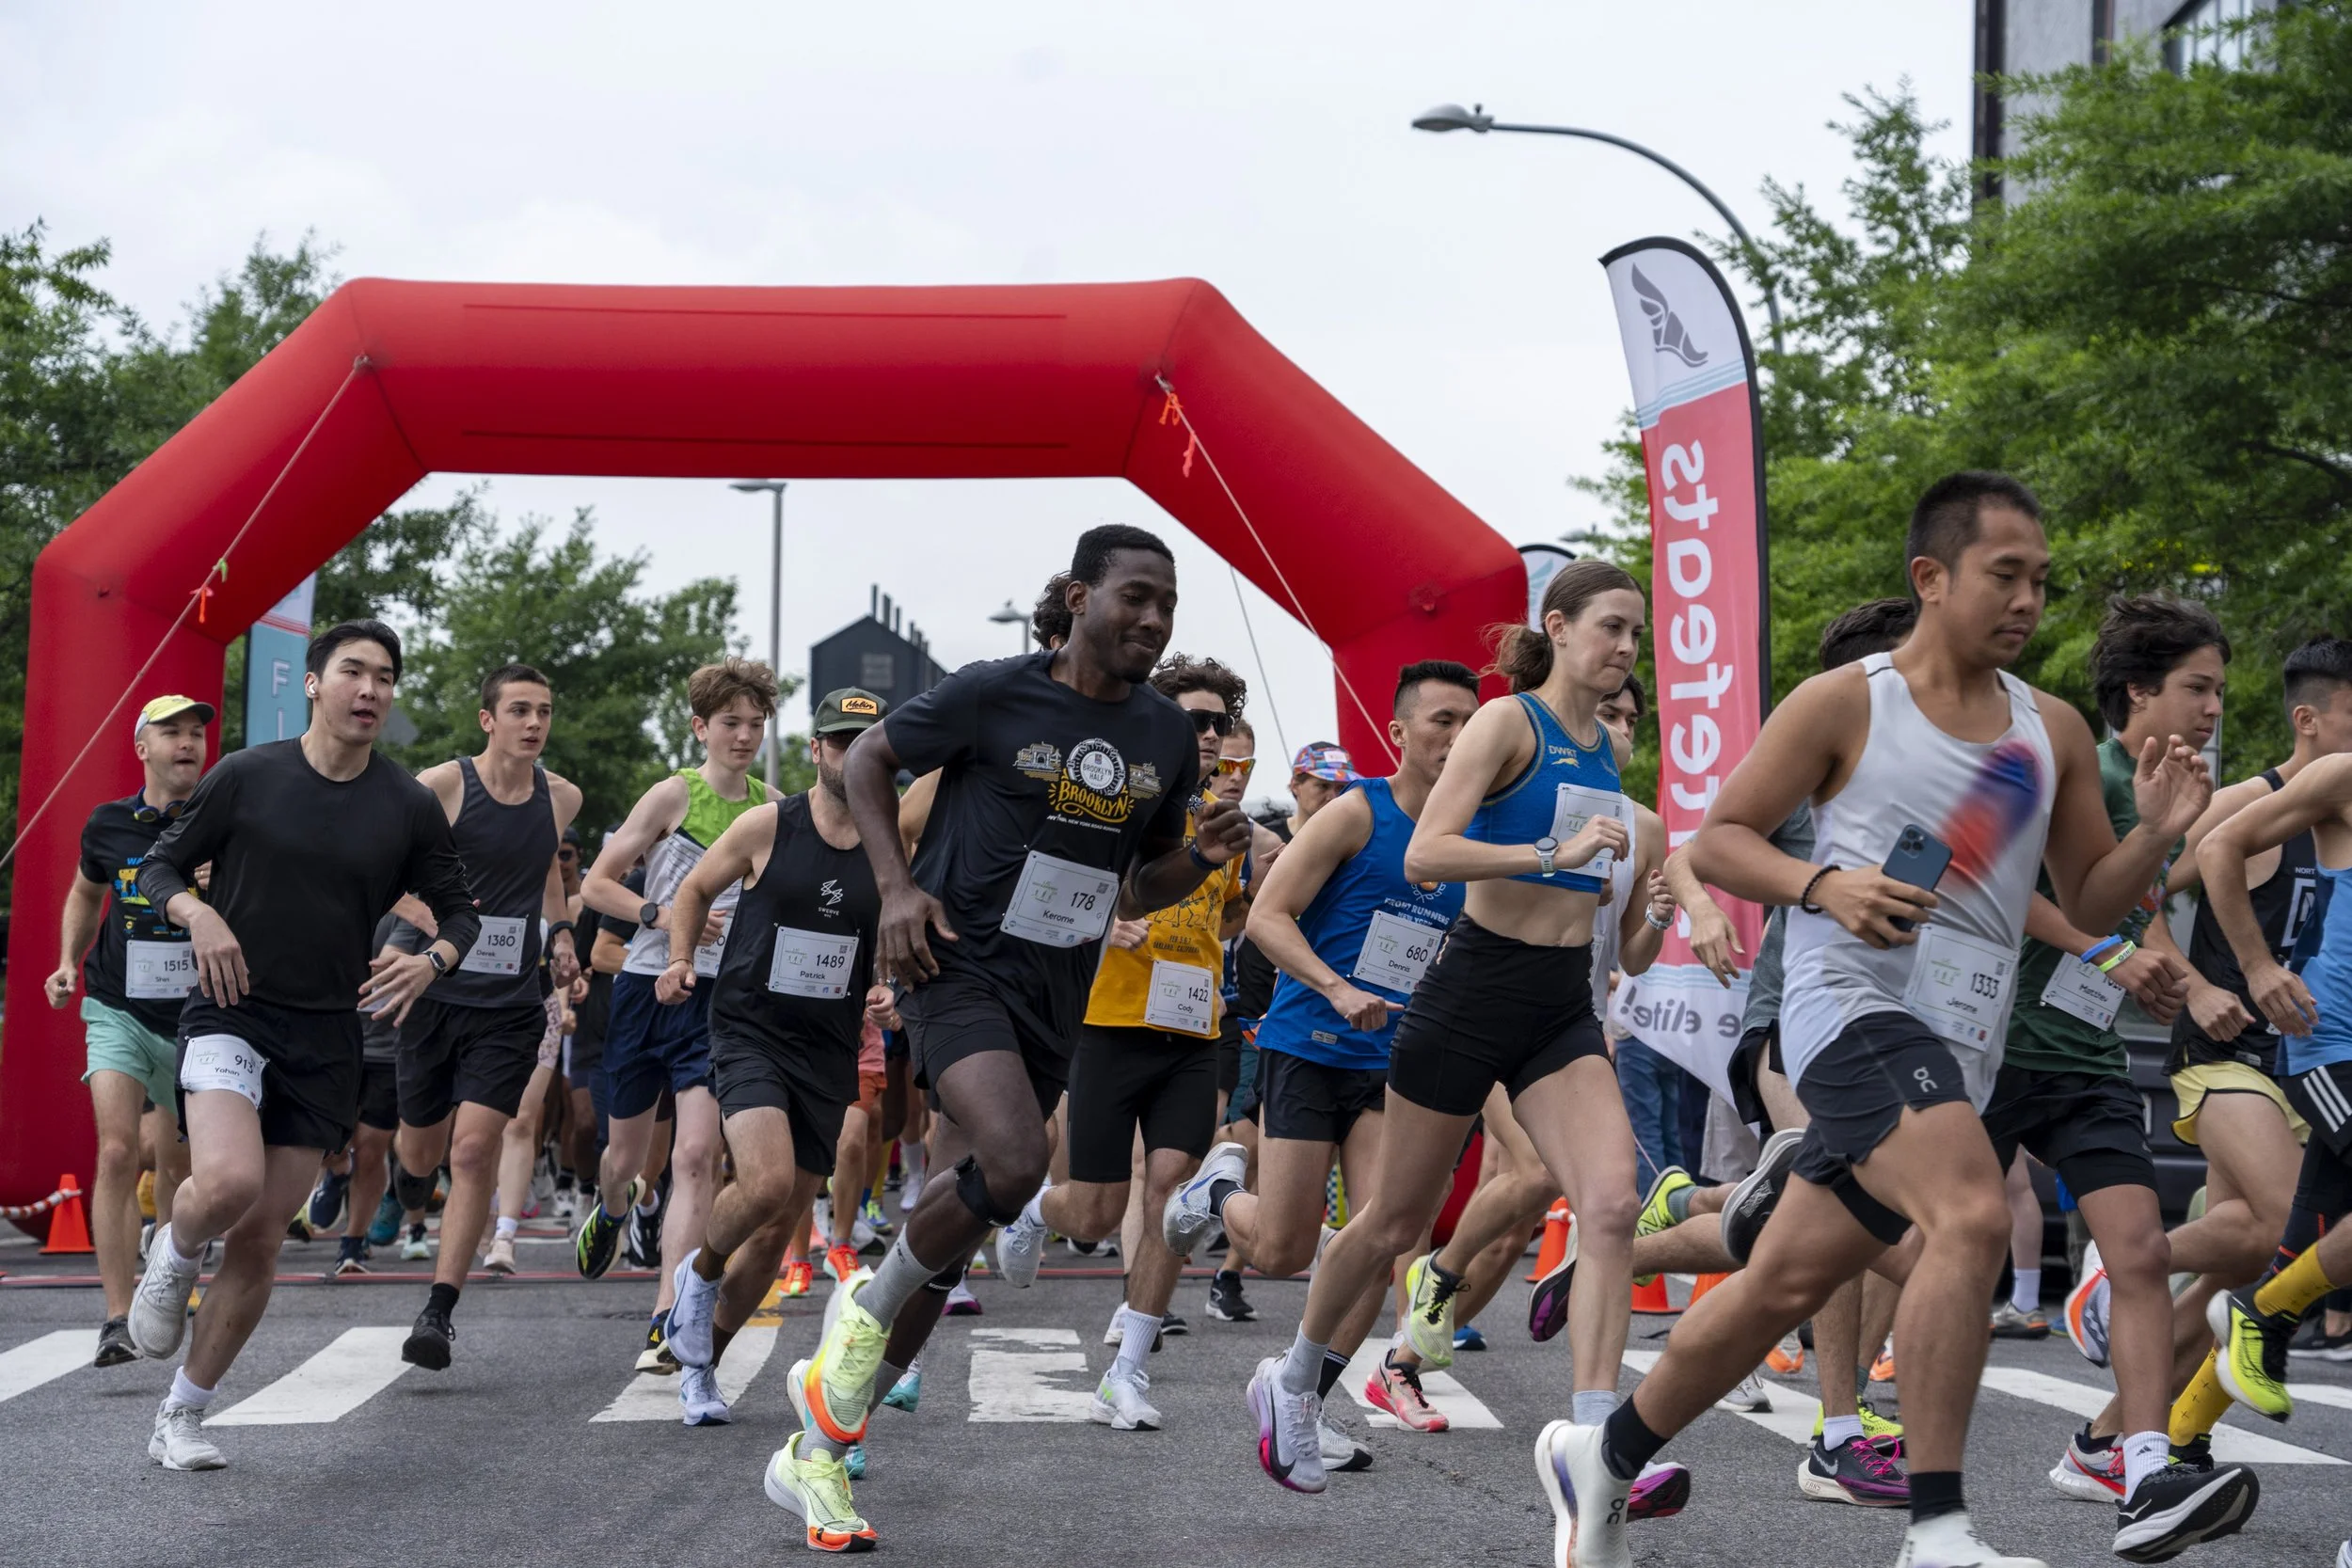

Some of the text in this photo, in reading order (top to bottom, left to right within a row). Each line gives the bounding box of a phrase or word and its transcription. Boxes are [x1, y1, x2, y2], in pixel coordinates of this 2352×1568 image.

[1082, 763, 1113, 776] BROOKLYN
[1089, 772, 1104, 781] HALF
[1058, 780, 1130, 817] BROOKLYN
[1071, 892, 1096, 911] 178
[1042, 910, 1074, 924] Kerome
[1411, 905, 1450, 926] RUNNERS
[487, 934, 516, 947] 1380
[700, 947, 717, 957] Dillon
[1406, 944, 1428, 962] 680
[164, 959, 189, 972] 1515
[816, 953, 845, 969] 1489
[1388, 959, 1410, 973] Dennis
[800, 970, 826, 980] Patrick
[1970, 972, 2000, 1000] 1333
[1188, 986, 1209, 1003] 1422
[1177, 1003, 1194, 1013] Cody
[1946, 996, 1979, 1014] Jerome
[234, 1054, 254, 1074] 913
[215, 1067, 240, 1077] Yohan
